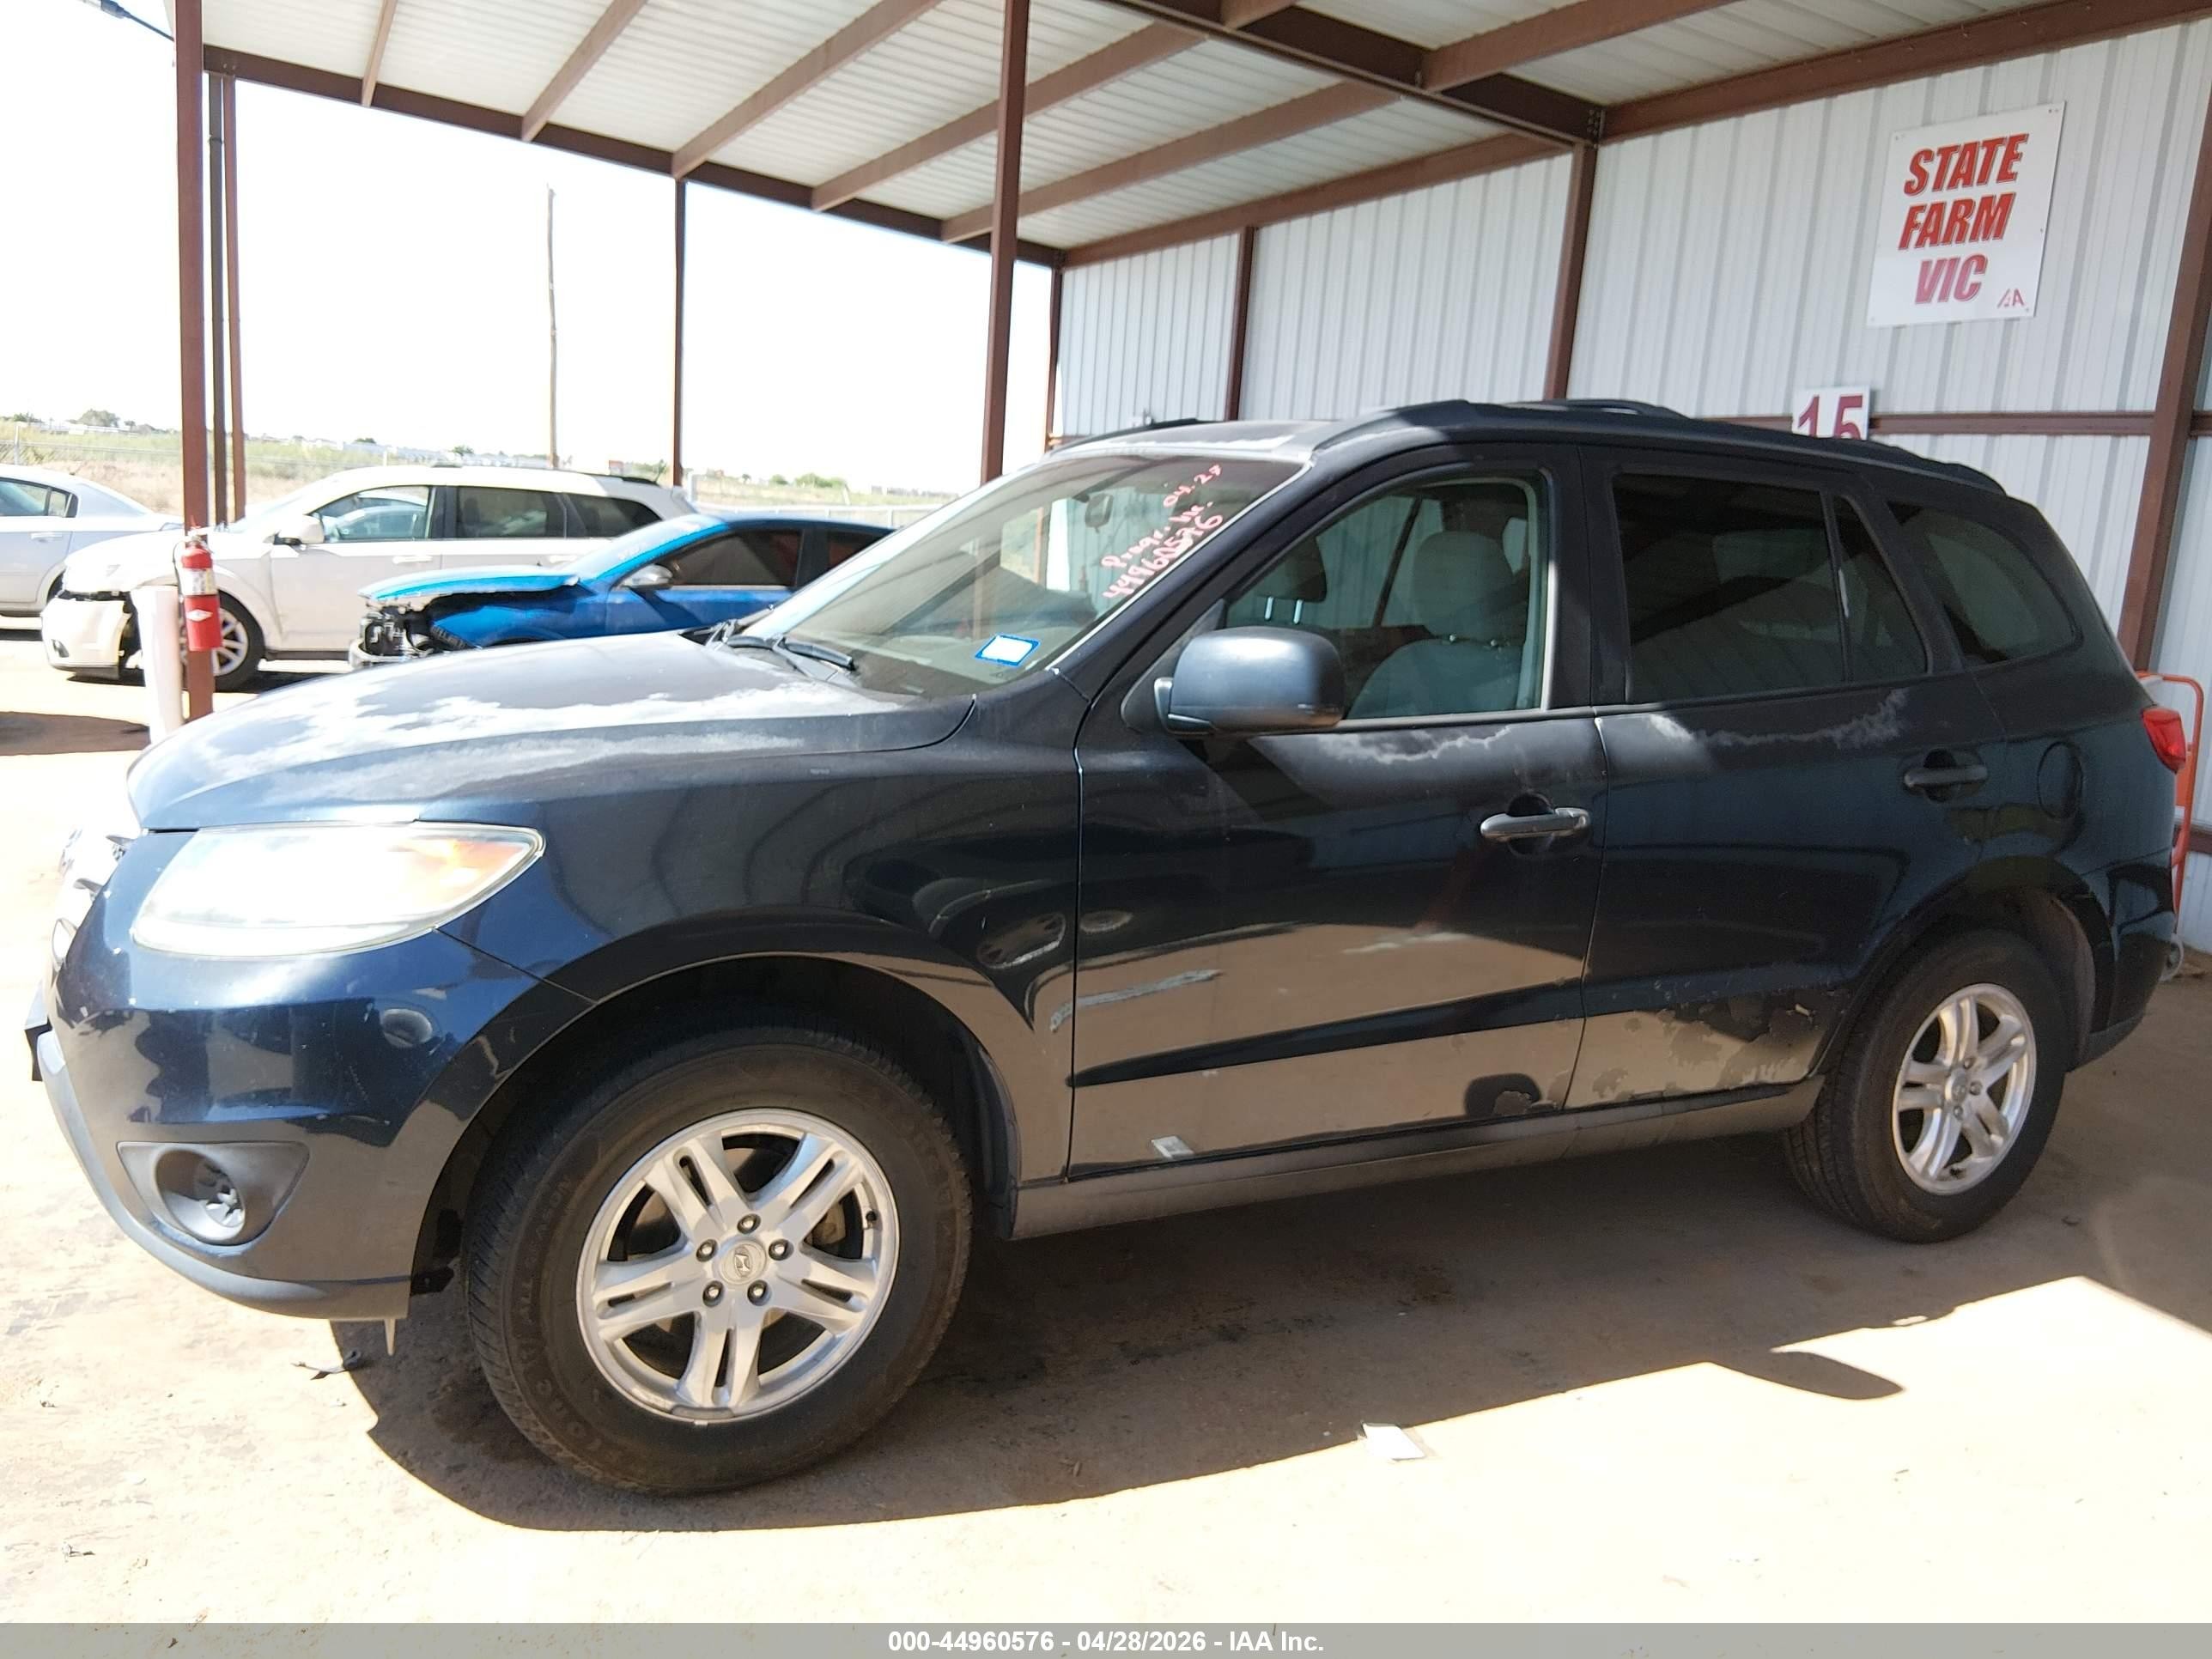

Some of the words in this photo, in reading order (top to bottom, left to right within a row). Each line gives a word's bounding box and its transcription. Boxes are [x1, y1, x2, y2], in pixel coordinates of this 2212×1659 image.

[1904, 133, 2029, 197] STATE
[1898, 192, 2016, 251] FARM
[1915, 253, 1988, 305] VIC
[1796, 394, 1863, 440] 15
